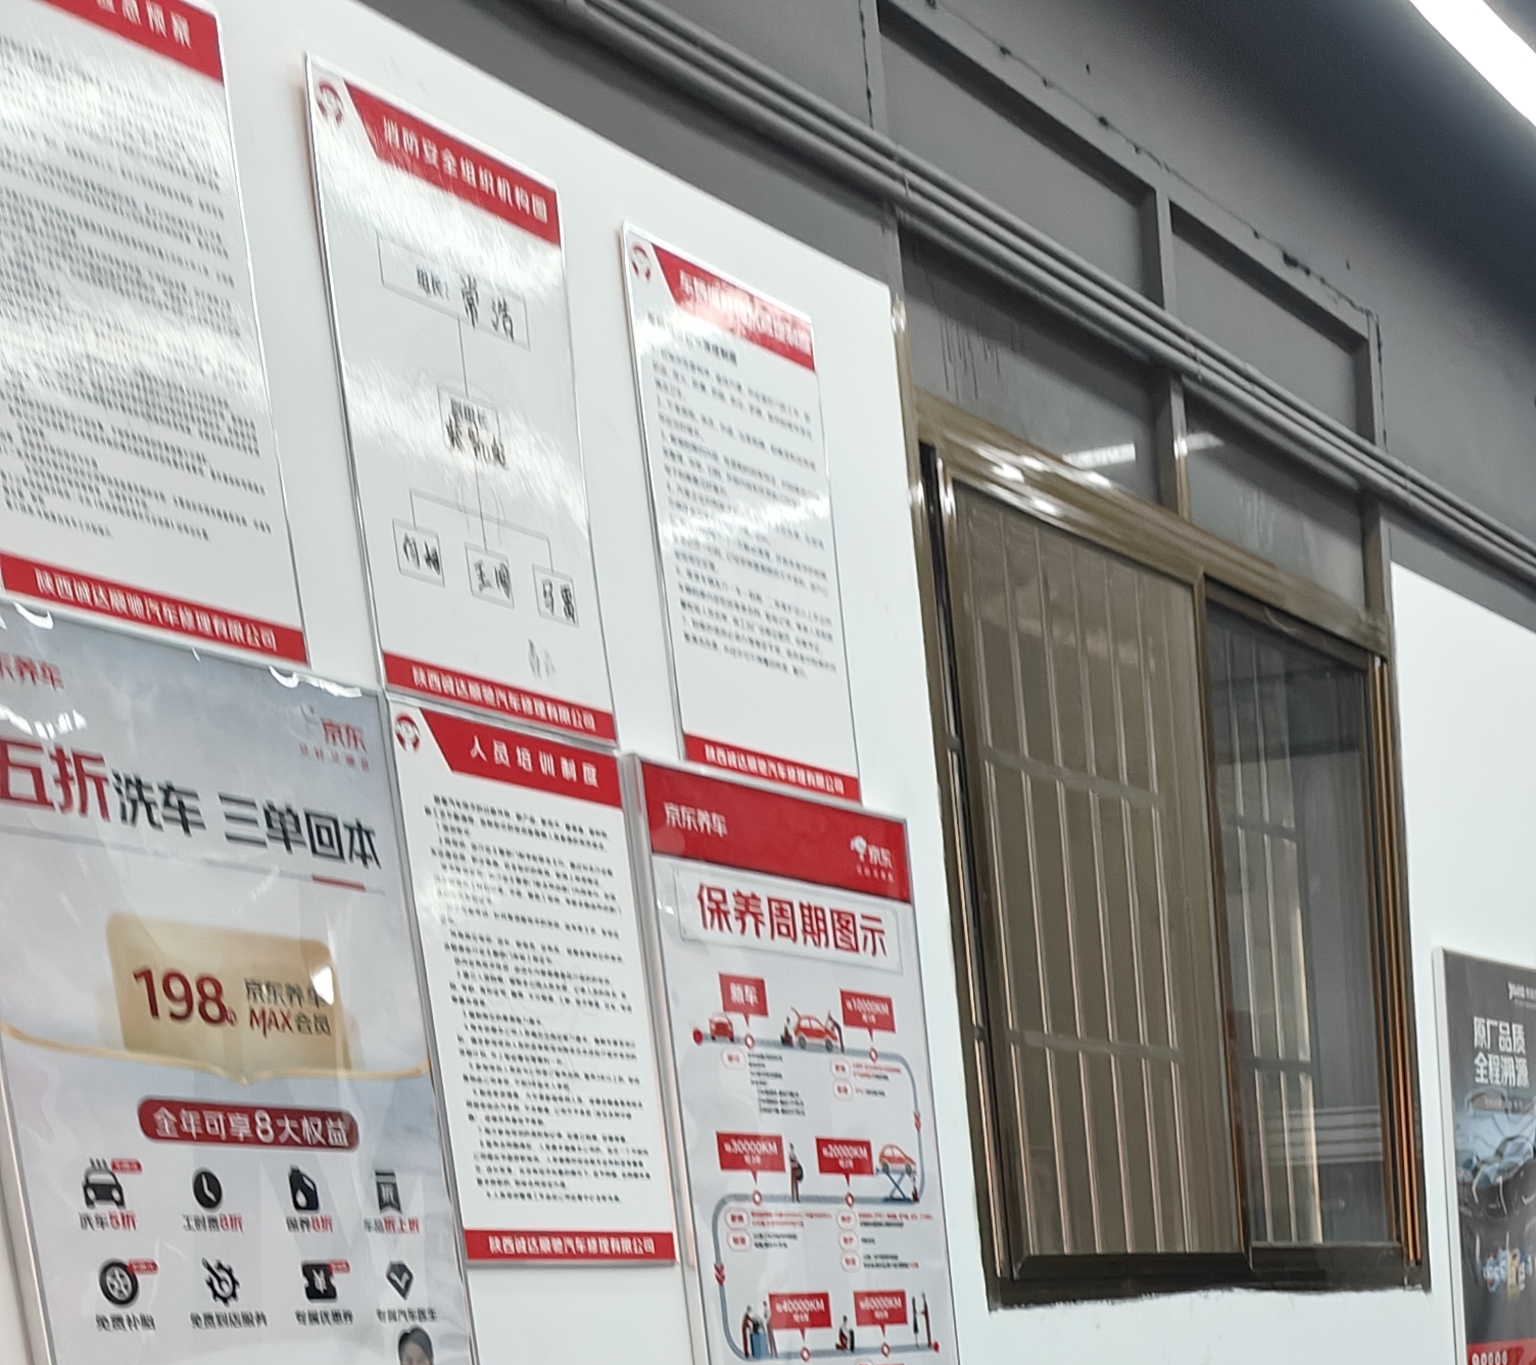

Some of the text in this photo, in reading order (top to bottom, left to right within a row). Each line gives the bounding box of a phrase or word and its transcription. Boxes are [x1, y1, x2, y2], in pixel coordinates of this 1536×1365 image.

[382, 115, 548, 223] 消防安全组织机构图
[469, 735, 598, 788] 人员培训制度
[218, 791, 382, 869] 三单回本
[664, 802, 728, 838] 京东养车
[697, 882, 888, 957] 保养周期图示
[1473, 1015, 1526, 1055] 原厂品质
[1474, 1050, 1530, 1089] 全程溯源
[152, 1105, 350, 1147] 全年可享8大权益
